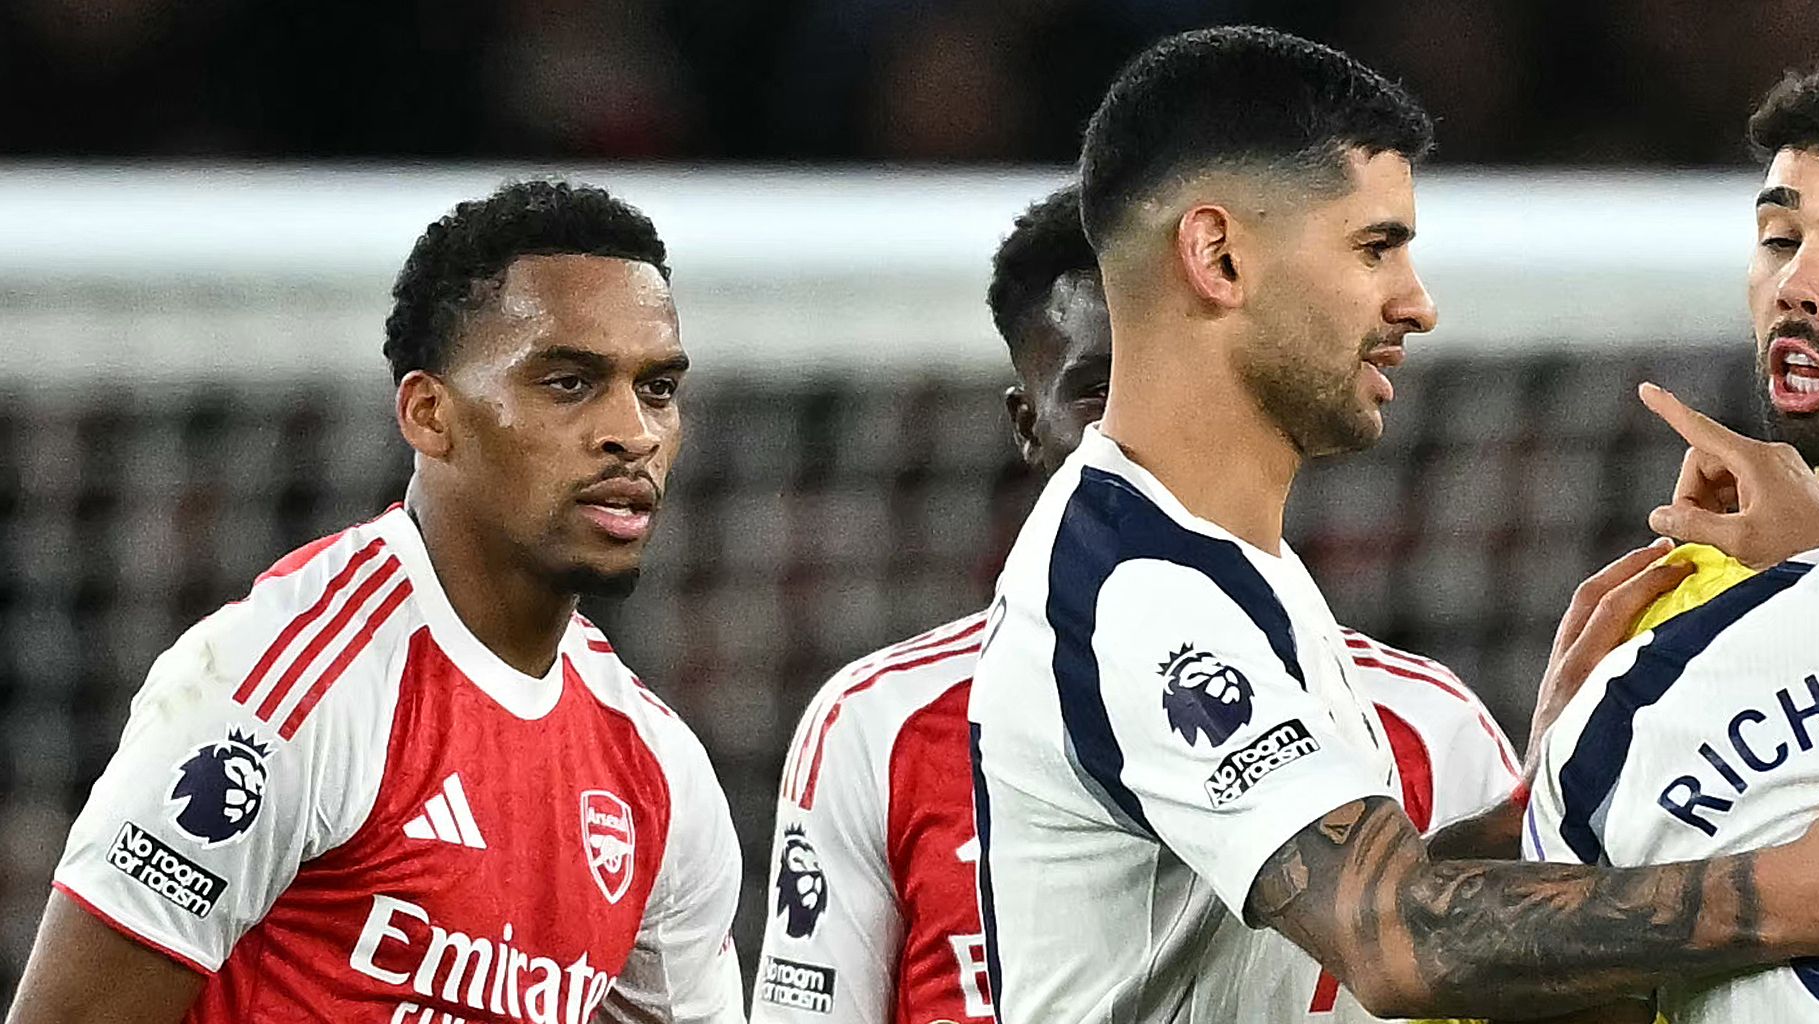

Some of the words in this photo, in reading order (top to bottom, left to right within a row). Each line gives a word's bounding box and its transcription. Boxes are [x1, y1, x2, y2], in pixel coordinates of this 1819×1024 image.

[1205, 765, 1237, 799] No
[1231, 726, 1299, 771] room
[1208, 778, 1242, 809] for
[1242, 736, 1320, 788] racism
[106, 842, 144, 874] for
[138, 864, 212, 918] racism
[116, 822, 153, 858] No
[150, 848, 214, 896] room
